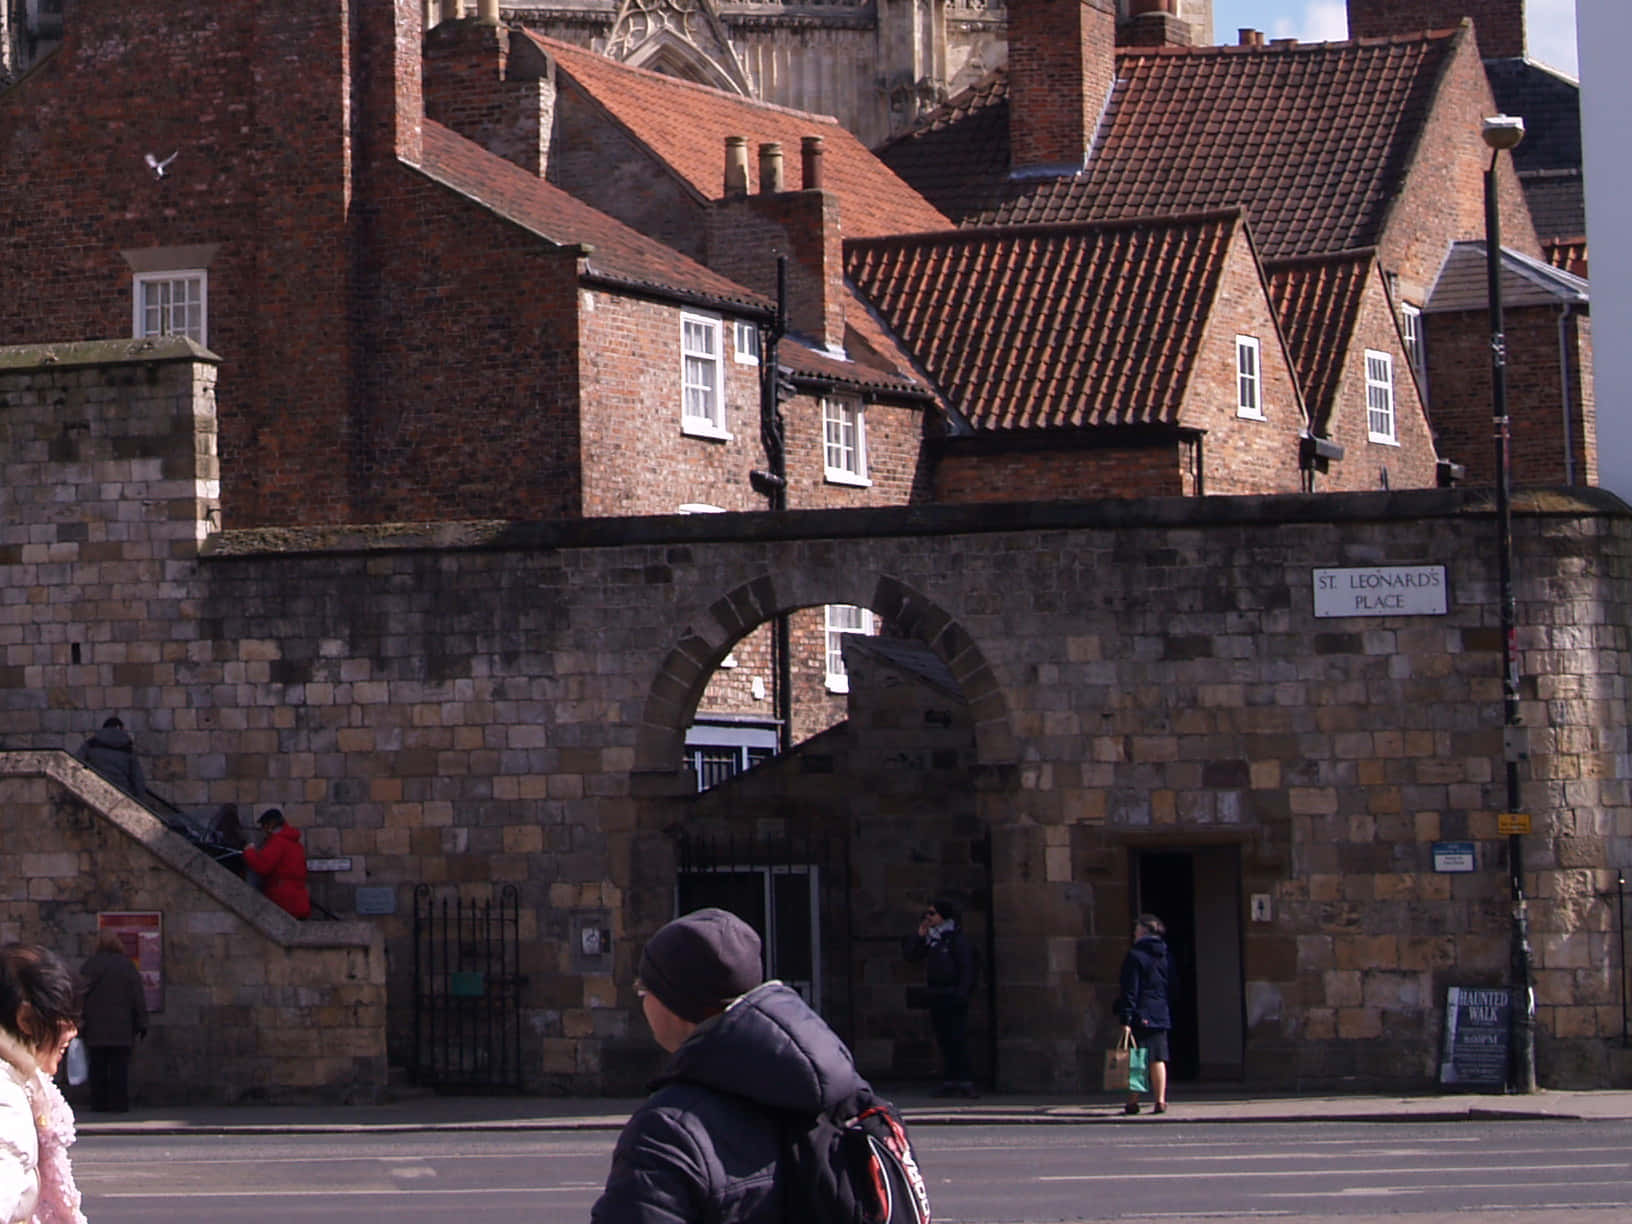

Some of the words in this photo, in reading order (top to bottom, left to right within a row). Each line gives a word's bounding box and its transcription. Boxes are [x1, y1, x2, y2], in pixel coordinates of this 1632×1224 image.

[1354, 594, 1405, 609] PLACE
[1459, 991, 1509, 1007] HAUNTED
[1469, 1006, 1499, 1023] WALK
